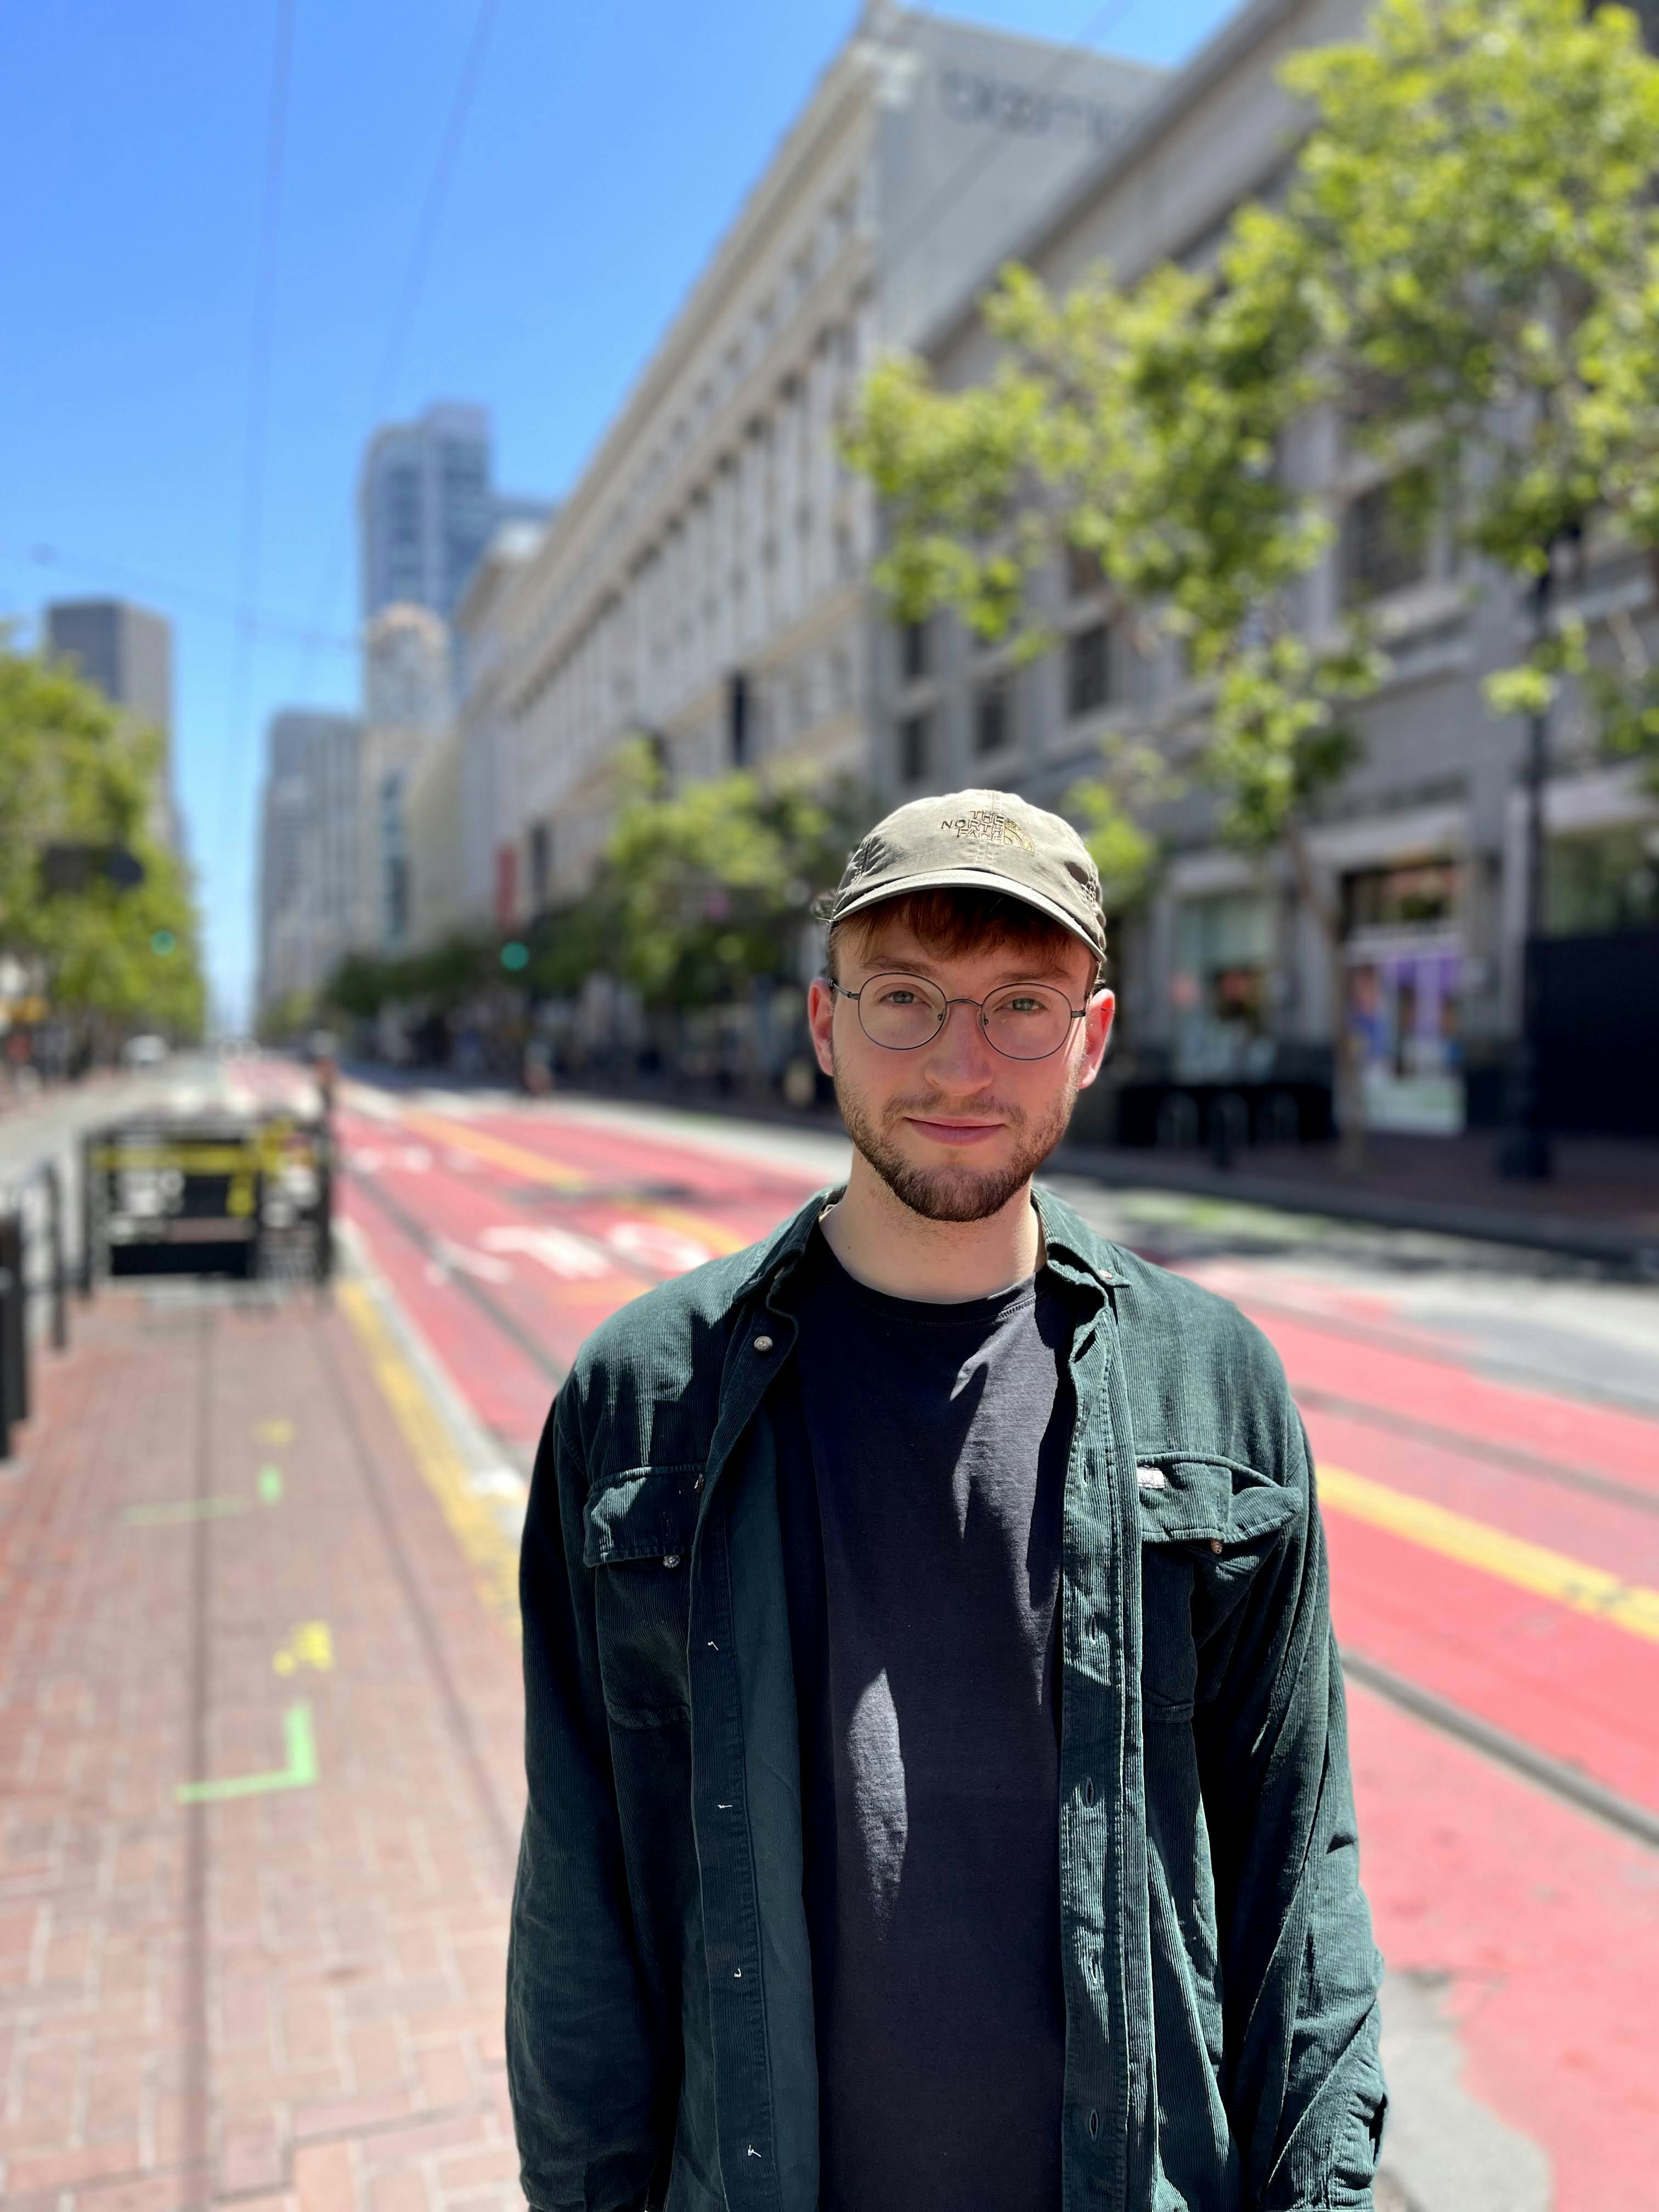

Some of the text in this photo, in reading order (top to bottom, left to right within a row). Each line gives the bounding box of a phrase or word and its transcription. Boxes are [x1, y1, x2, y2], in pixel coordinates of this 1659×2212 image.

[970, 810, 1005, 826] THE
[941, 818, 1003, 836] NORTH
[957, 828, 1002, 841] FACE
